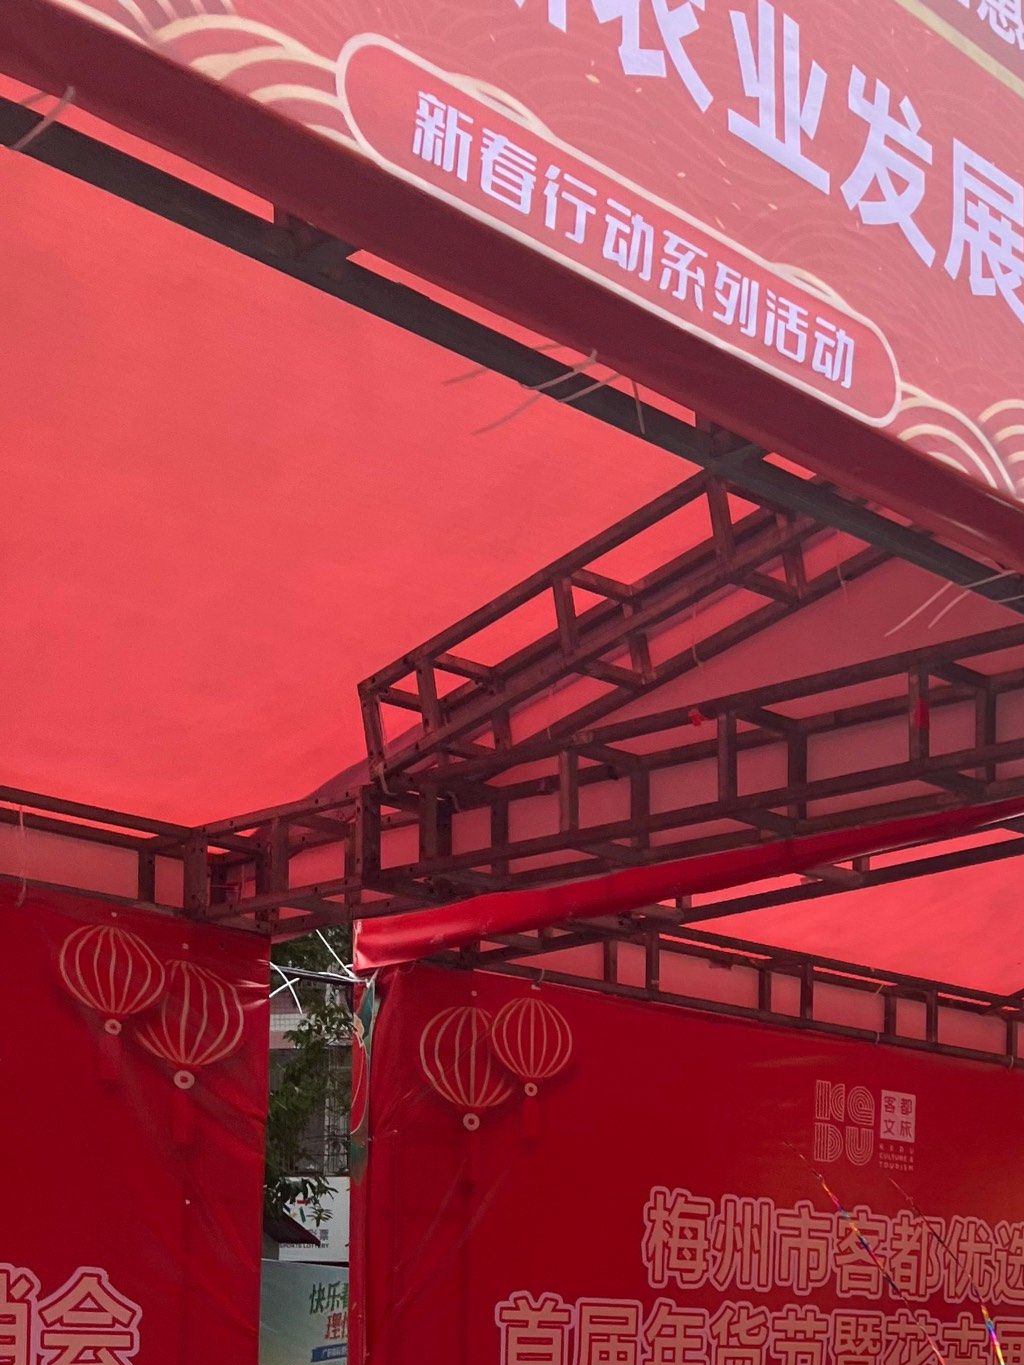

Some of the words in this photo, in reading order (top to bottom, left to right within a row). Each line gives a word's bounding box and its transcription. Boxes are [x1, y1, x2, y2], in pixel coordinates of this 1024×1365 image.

[412, 91, 855, 389] 新春行动系列活动
